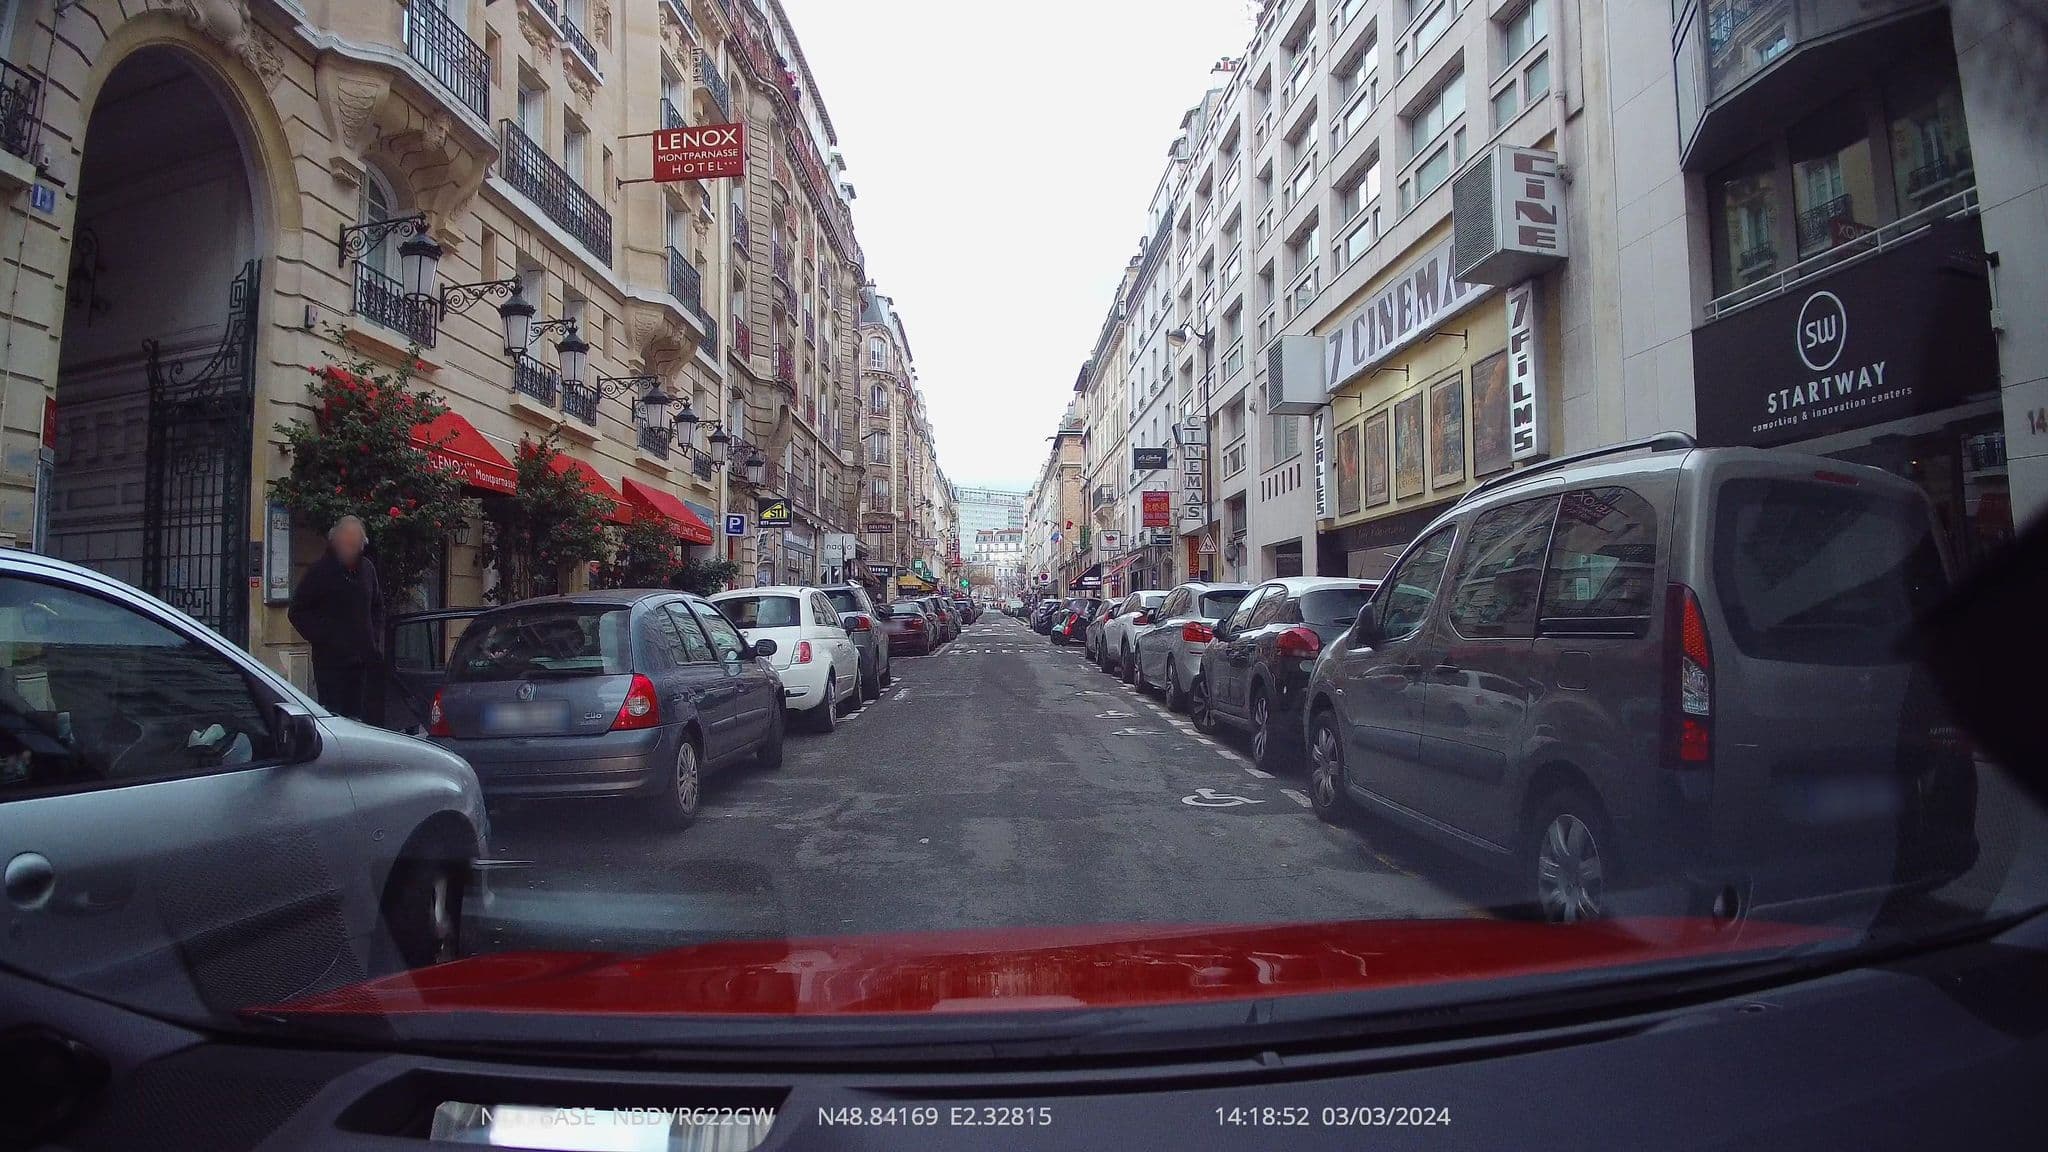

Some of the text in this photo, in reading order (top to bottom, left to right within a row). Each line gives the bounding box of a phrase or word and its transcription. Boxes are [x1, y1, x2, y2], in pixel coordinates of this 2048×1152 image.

[657, 149, 738, 163] MONTPARNASSE
[658, 128, 738, 151] LENOX
[1329, 243, 1479, 386] 7 CINEMA
[1510, 290, 1529, 330] 7
[1805, 314, 1836, 349] SW
[1767, 361, 1886, 414] STARTWAY
[1752, 387, 1913, 433] coworking & innovation centers
[475, 468, 517, 489] Montparnasse
[1186, 415, 1201, 518] CINEMAS
[1315, 413, 1325, 516] 7 SALLES
[729, 517, 741, 528] P
